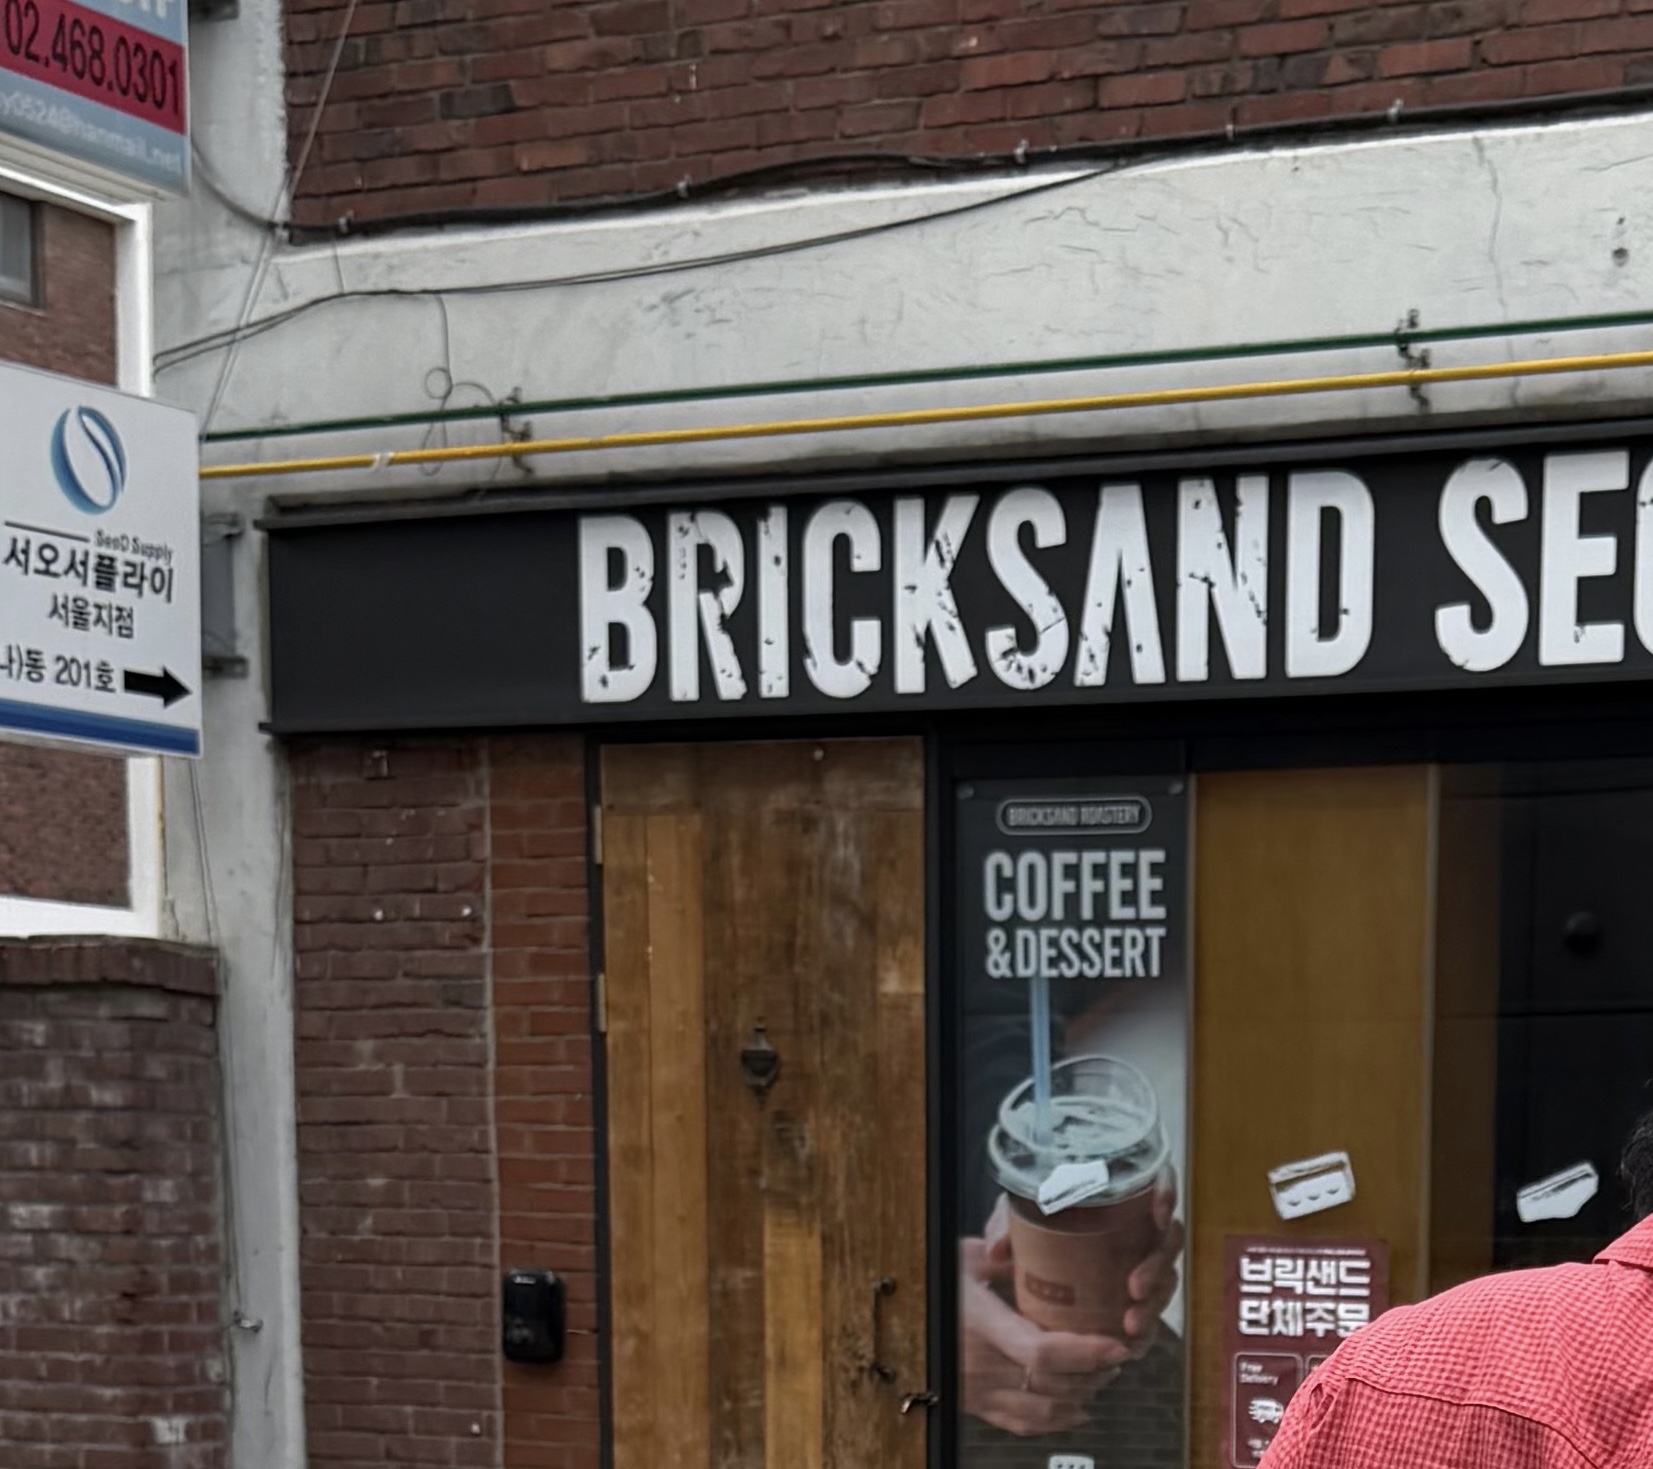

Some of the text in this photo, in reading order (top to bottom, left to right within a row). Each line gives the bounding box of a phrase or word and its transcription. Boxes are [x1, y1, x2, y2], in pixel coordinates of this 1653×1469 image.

[4, 0, 181, 117] 02.468.0301
[3, 535, 174, 604] 서오서플라이
[579, 469, 1376, 703] BRICKSAND
[48, 593, 135, 640] 서울지점
[55, 654, 117, 693] 201호
[984, 849, 1167, 922] COFFEE
[985, 926, 1167, 979] &DESSERT
[1238, 1256, 1371, 1297] 브릭샌드
[1238, 1298, 1370, 1338] 단체주문
